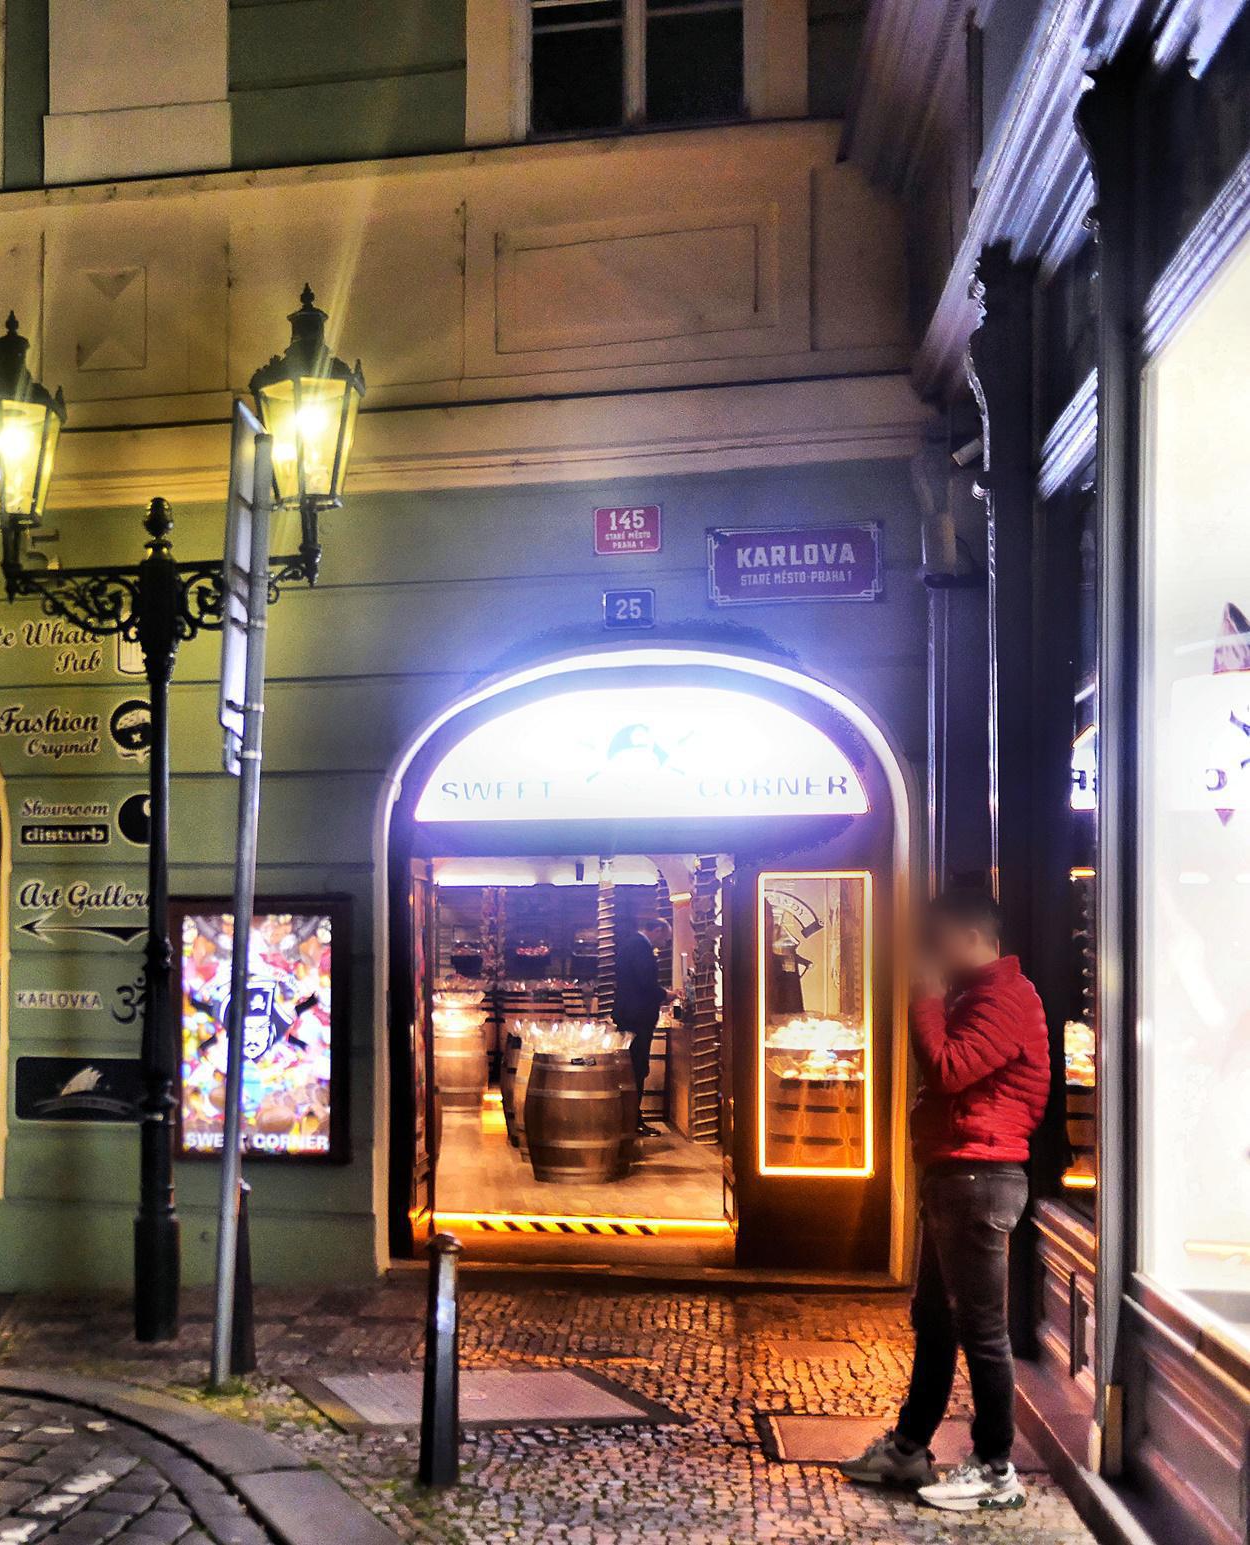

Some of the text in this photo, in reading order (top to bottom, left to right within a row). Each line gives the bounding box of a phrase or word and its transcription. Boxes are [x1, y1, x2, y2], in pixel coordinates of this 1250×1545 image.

[610, 509, 645, 531] 145
[612, 540, 645, 549] PRAHA 1
[736, 542, 856, 569] KARLOVA
[740, 572, 771, 586] STARÉ
[847, 570, 853, 582] 1
[615, 598, 643, 620] 25
[55, 649, 102, 674] Pub
[27, 737, 102, 759] Original
[699, 776, 848, 798] CORNER
[21, 798, 109, 816] Showroom
[25, 827, 106, 842] disturb
[17, 880, 150, 917] Art Galler
[16, 992, 102, 1009] KARLOVKA
[186, 1132, 330, 1152] SWET CORNER
